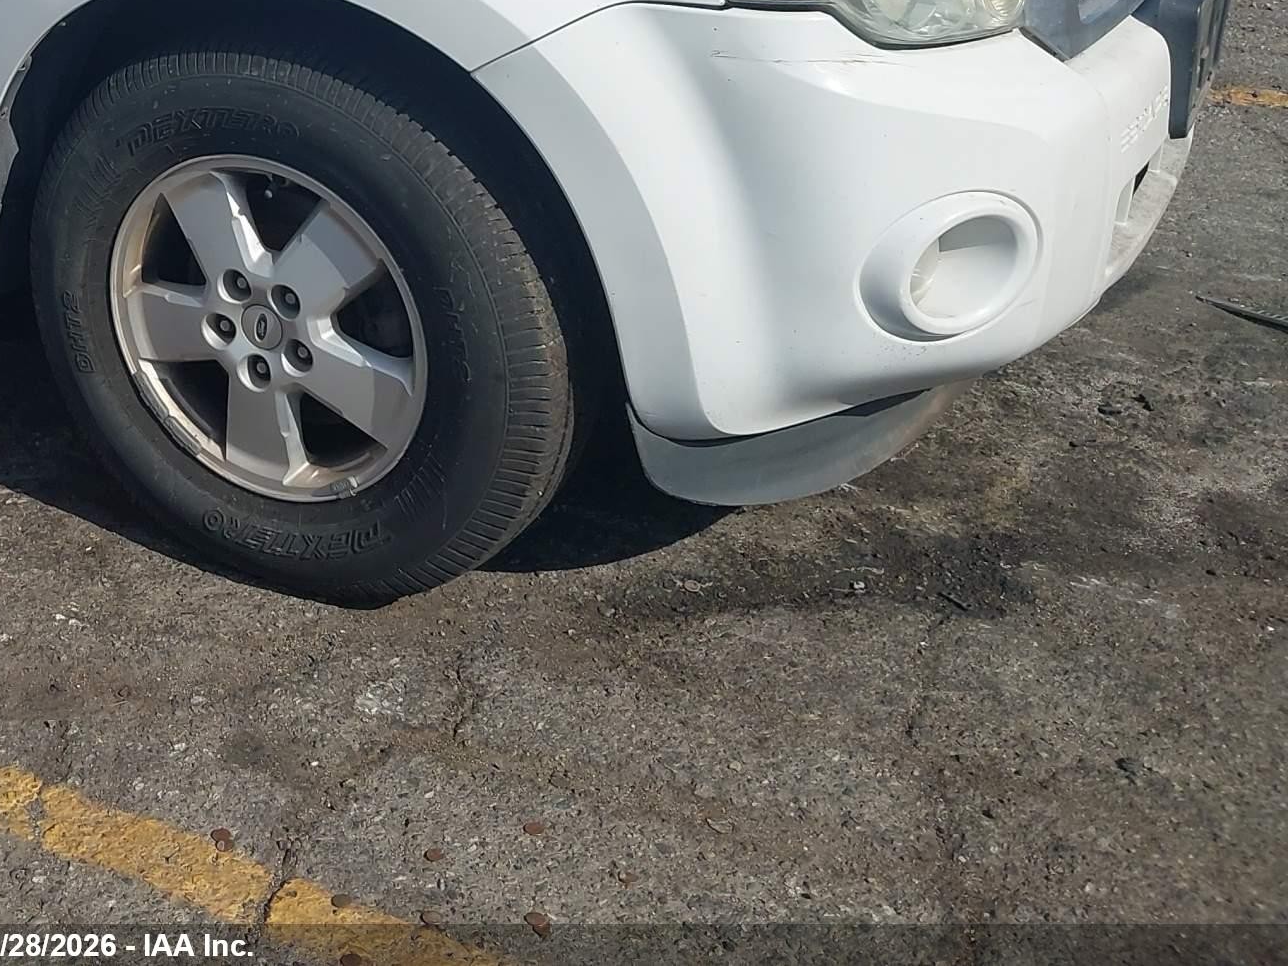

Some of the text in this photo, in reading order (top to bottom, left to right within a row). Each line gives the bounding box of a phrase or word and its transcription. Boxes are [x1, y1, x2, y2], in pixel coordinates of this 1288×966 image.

[114, 106, 301, 156] DEXTERO
[63, 289, 96, 373] DHT2
[202, 509, 394, 560] DEXTERO
